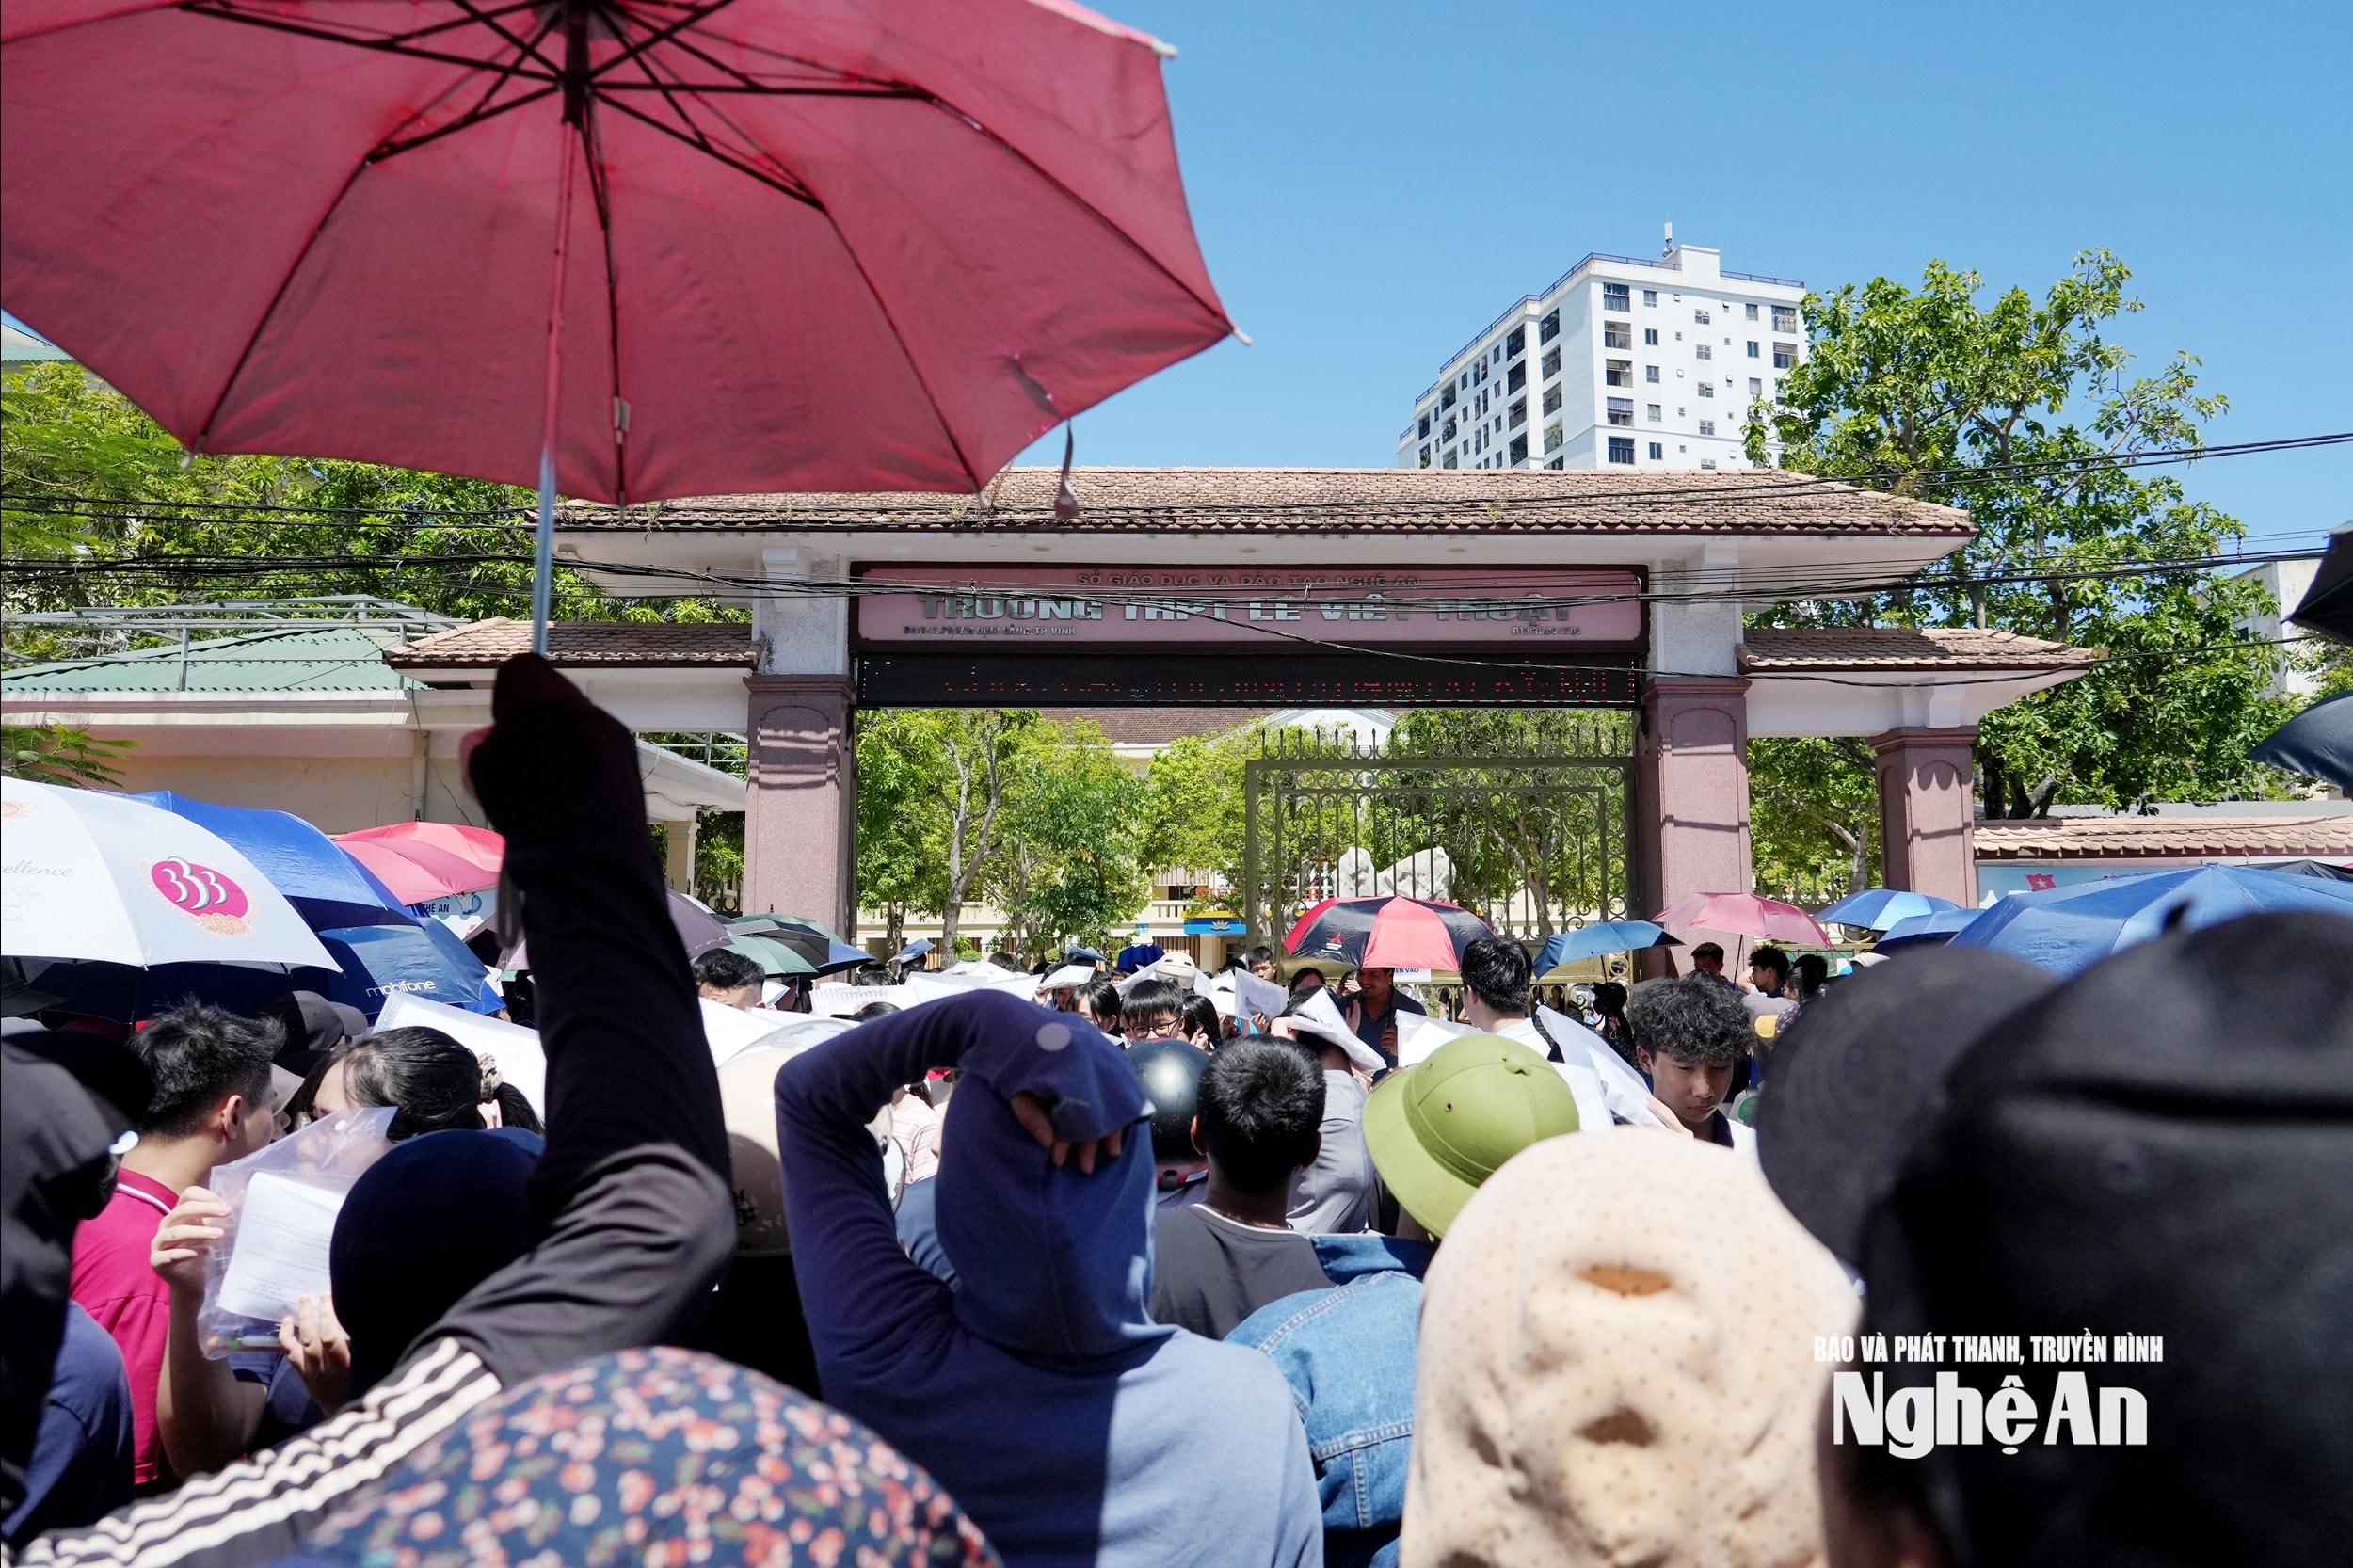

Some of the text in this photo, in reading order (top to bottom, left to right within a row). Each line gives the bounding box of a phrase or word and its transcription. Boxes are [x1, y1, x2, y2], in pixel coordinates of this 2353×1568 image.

[1108, 572, 1154, 585] GIÁO
[1050, 627, 1077, 636] VINH
[364, 980, 437, 998] mobifone
